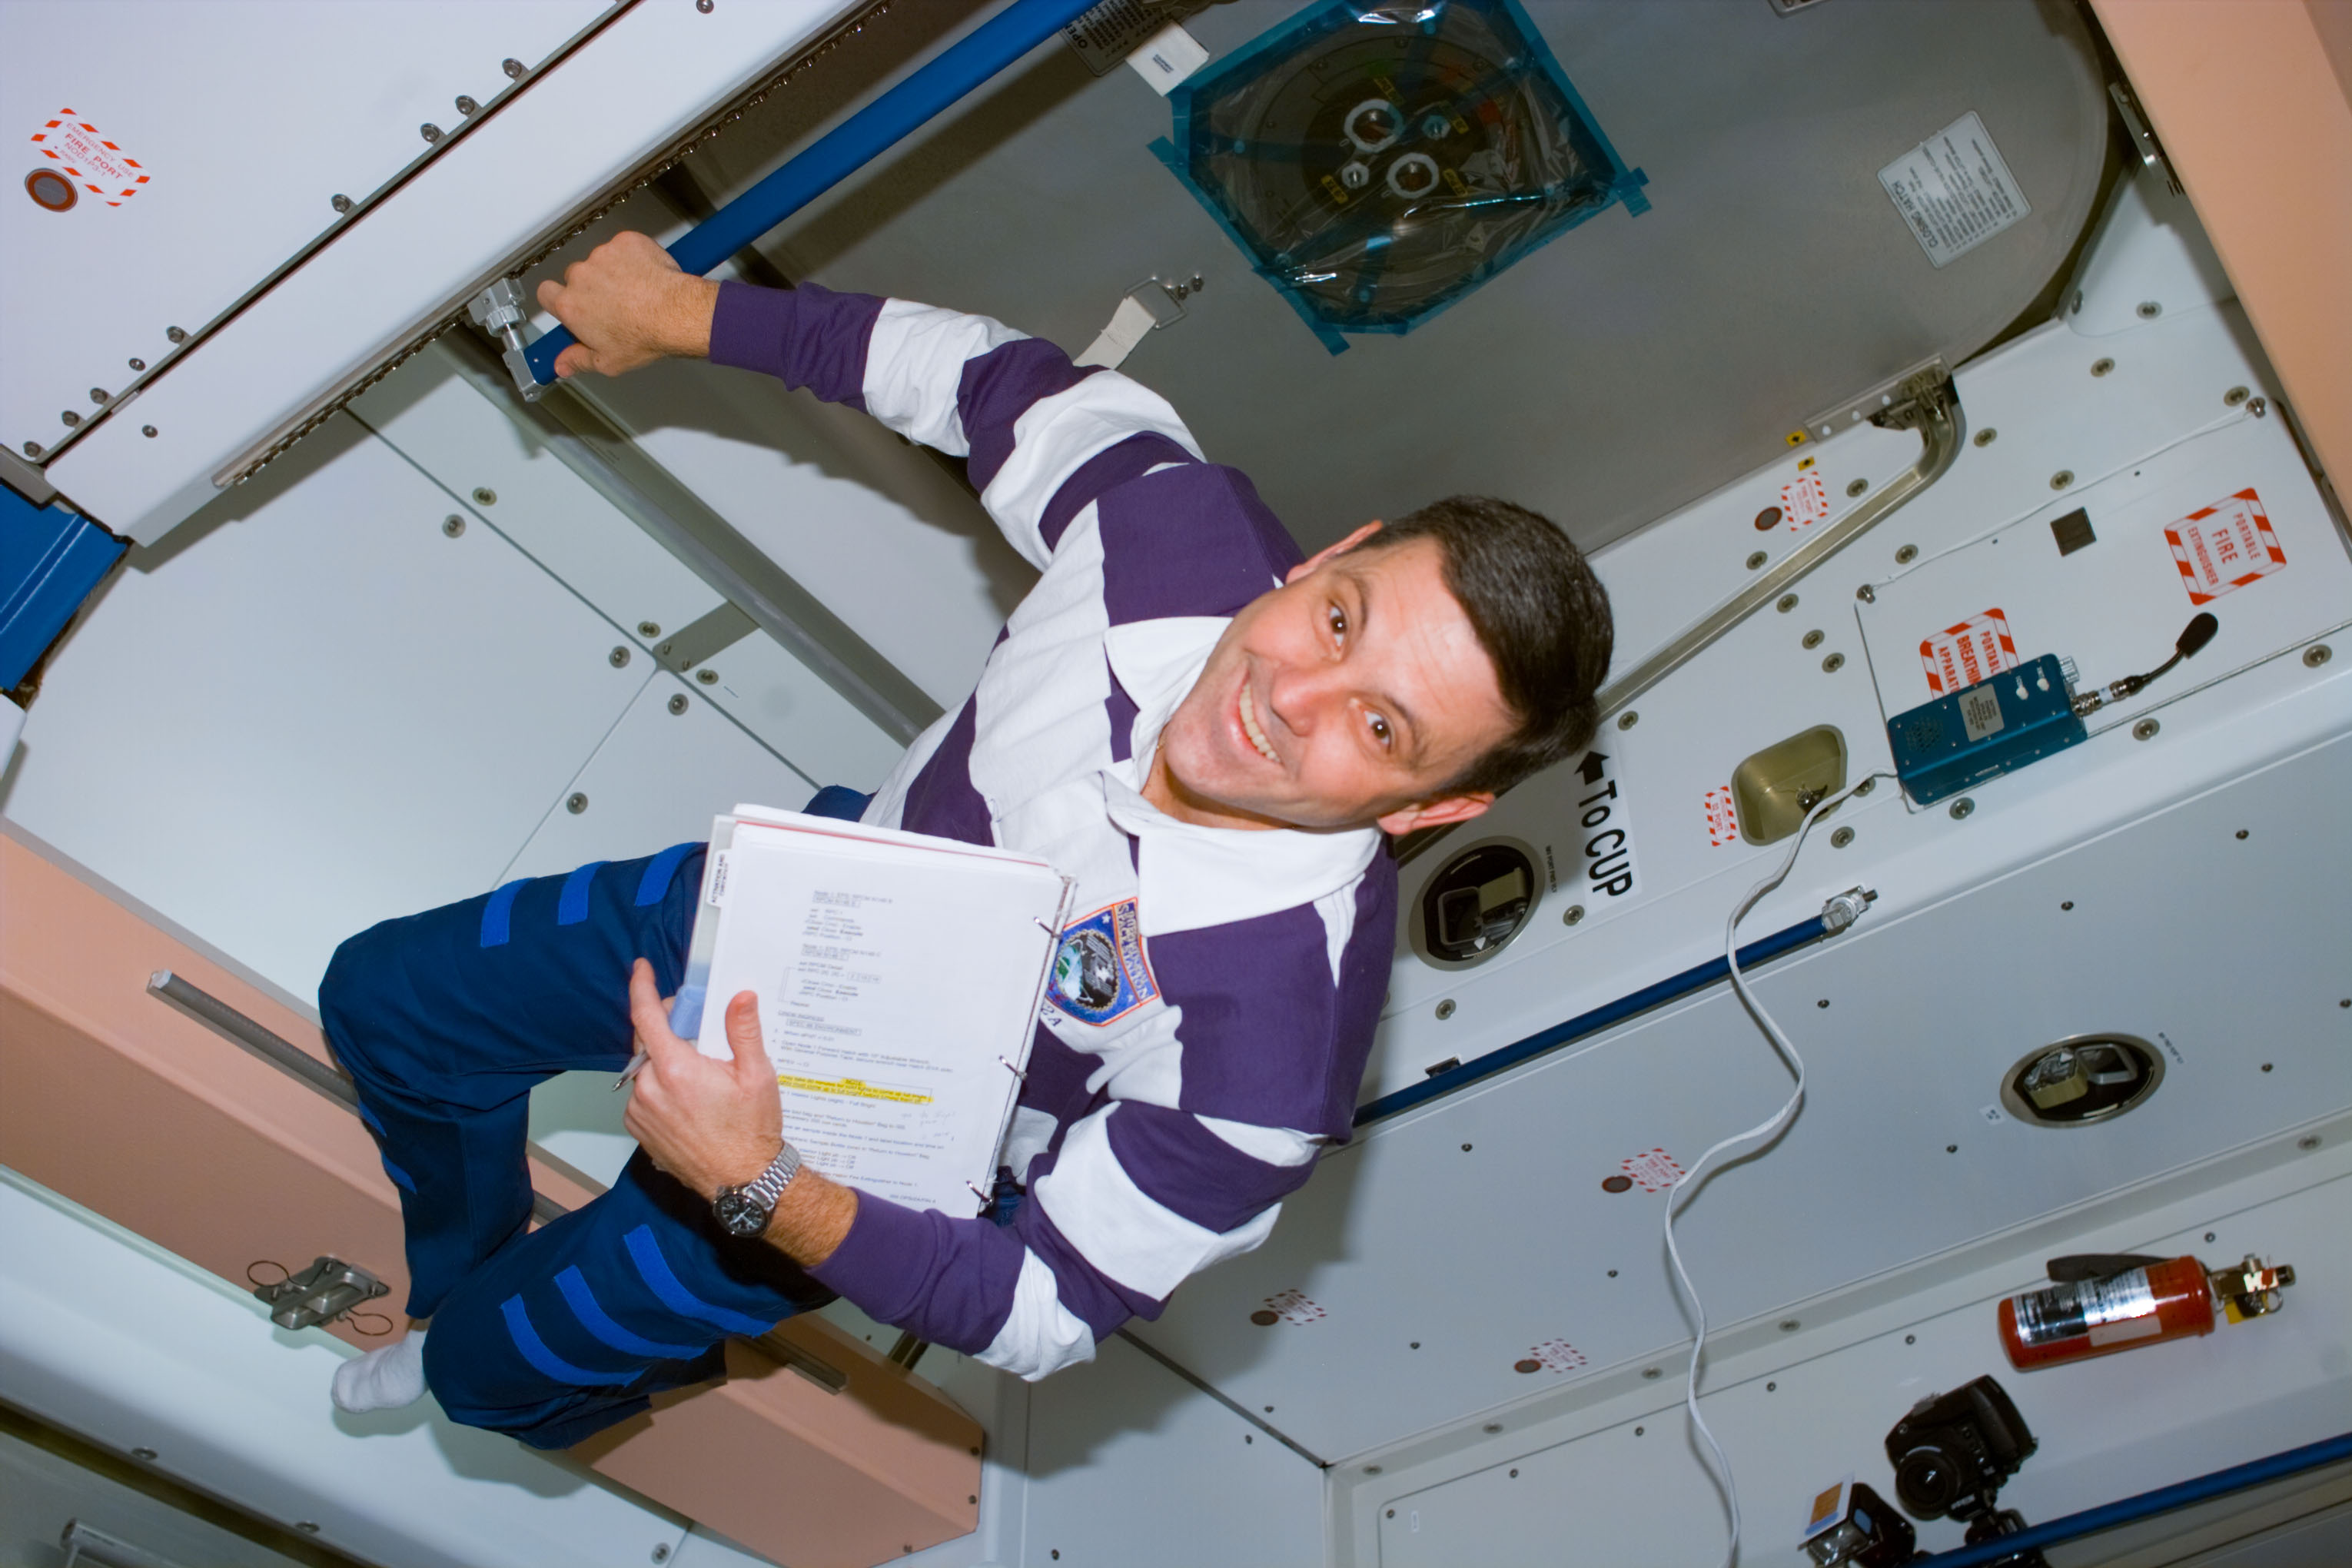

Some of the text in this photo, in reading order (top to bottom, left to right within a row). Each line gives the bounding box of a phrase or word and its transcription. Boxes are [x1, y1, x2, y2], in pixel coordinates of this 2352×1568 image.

[64, 131, 90, 154] FIRE
[92, 154, 123, 181] PORT
[65, 121, 115, 163] EMERGENCY
[117, 162, 135, 178] USE
[1891, 179, 1938, 248] CLOSING HATCH
[2187, 526, 2219, 586] EXTINGUISHER
[2211, 527, 2238, 564] FIRE
[2232, 511, 2261, 560] PORTABLE
[1955, 634, 1982, 686] BREATHIN
[1978, 630, 2002, 676] PORTABL
[1578, 779, 1633, 896] To CUP
[1713, 812, 1722, 831] PORT
